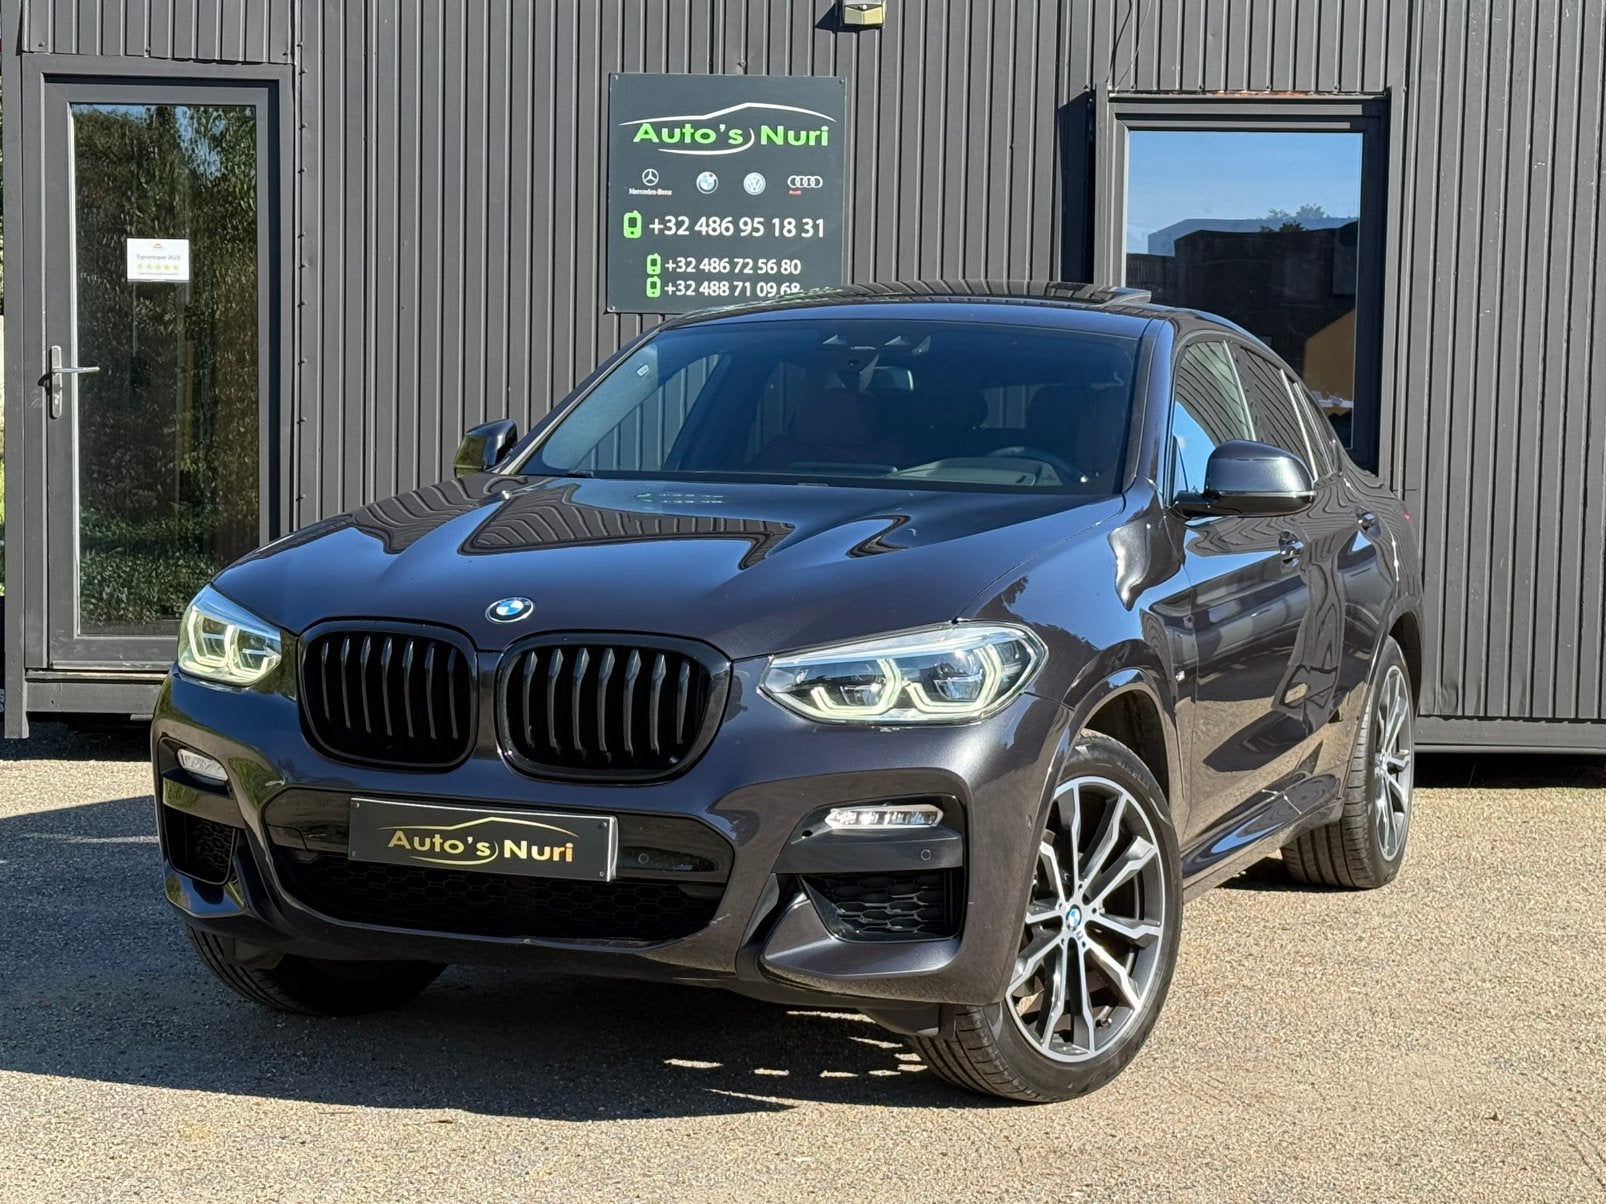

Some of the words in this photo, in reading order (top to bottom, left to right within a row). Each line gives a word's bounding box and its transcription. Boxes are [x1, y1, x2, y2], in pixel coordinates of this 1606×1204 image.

[632, 123, 744, 145] Auto's
[760, 125, 829, 146] Nuri
[628, 187, 673, 196] Mercedes-Benz
[648, 215, 690, 235] +32
[694, 216, 734, 236] 486
[739, 217, 765, 237] 95
[771, 217, 796, 237] 18
[801, 218, 824, 238] 31
[664, 257, 696, 273] +32
[699, 257, 730, 273] 486
[733, 258, 753, 274] 72
[757, 258, 777, 274] 56
[780, 259, 801, 275] 80
[664, 280, 696, 296] +32
[699, 281, 730, 297] 488
[733, 281, 751, 297] 71
[756, 281, 777, 297] 09
[387, 830, 491, 857] Auto's
[503, 839, 574, 862] Nuri
